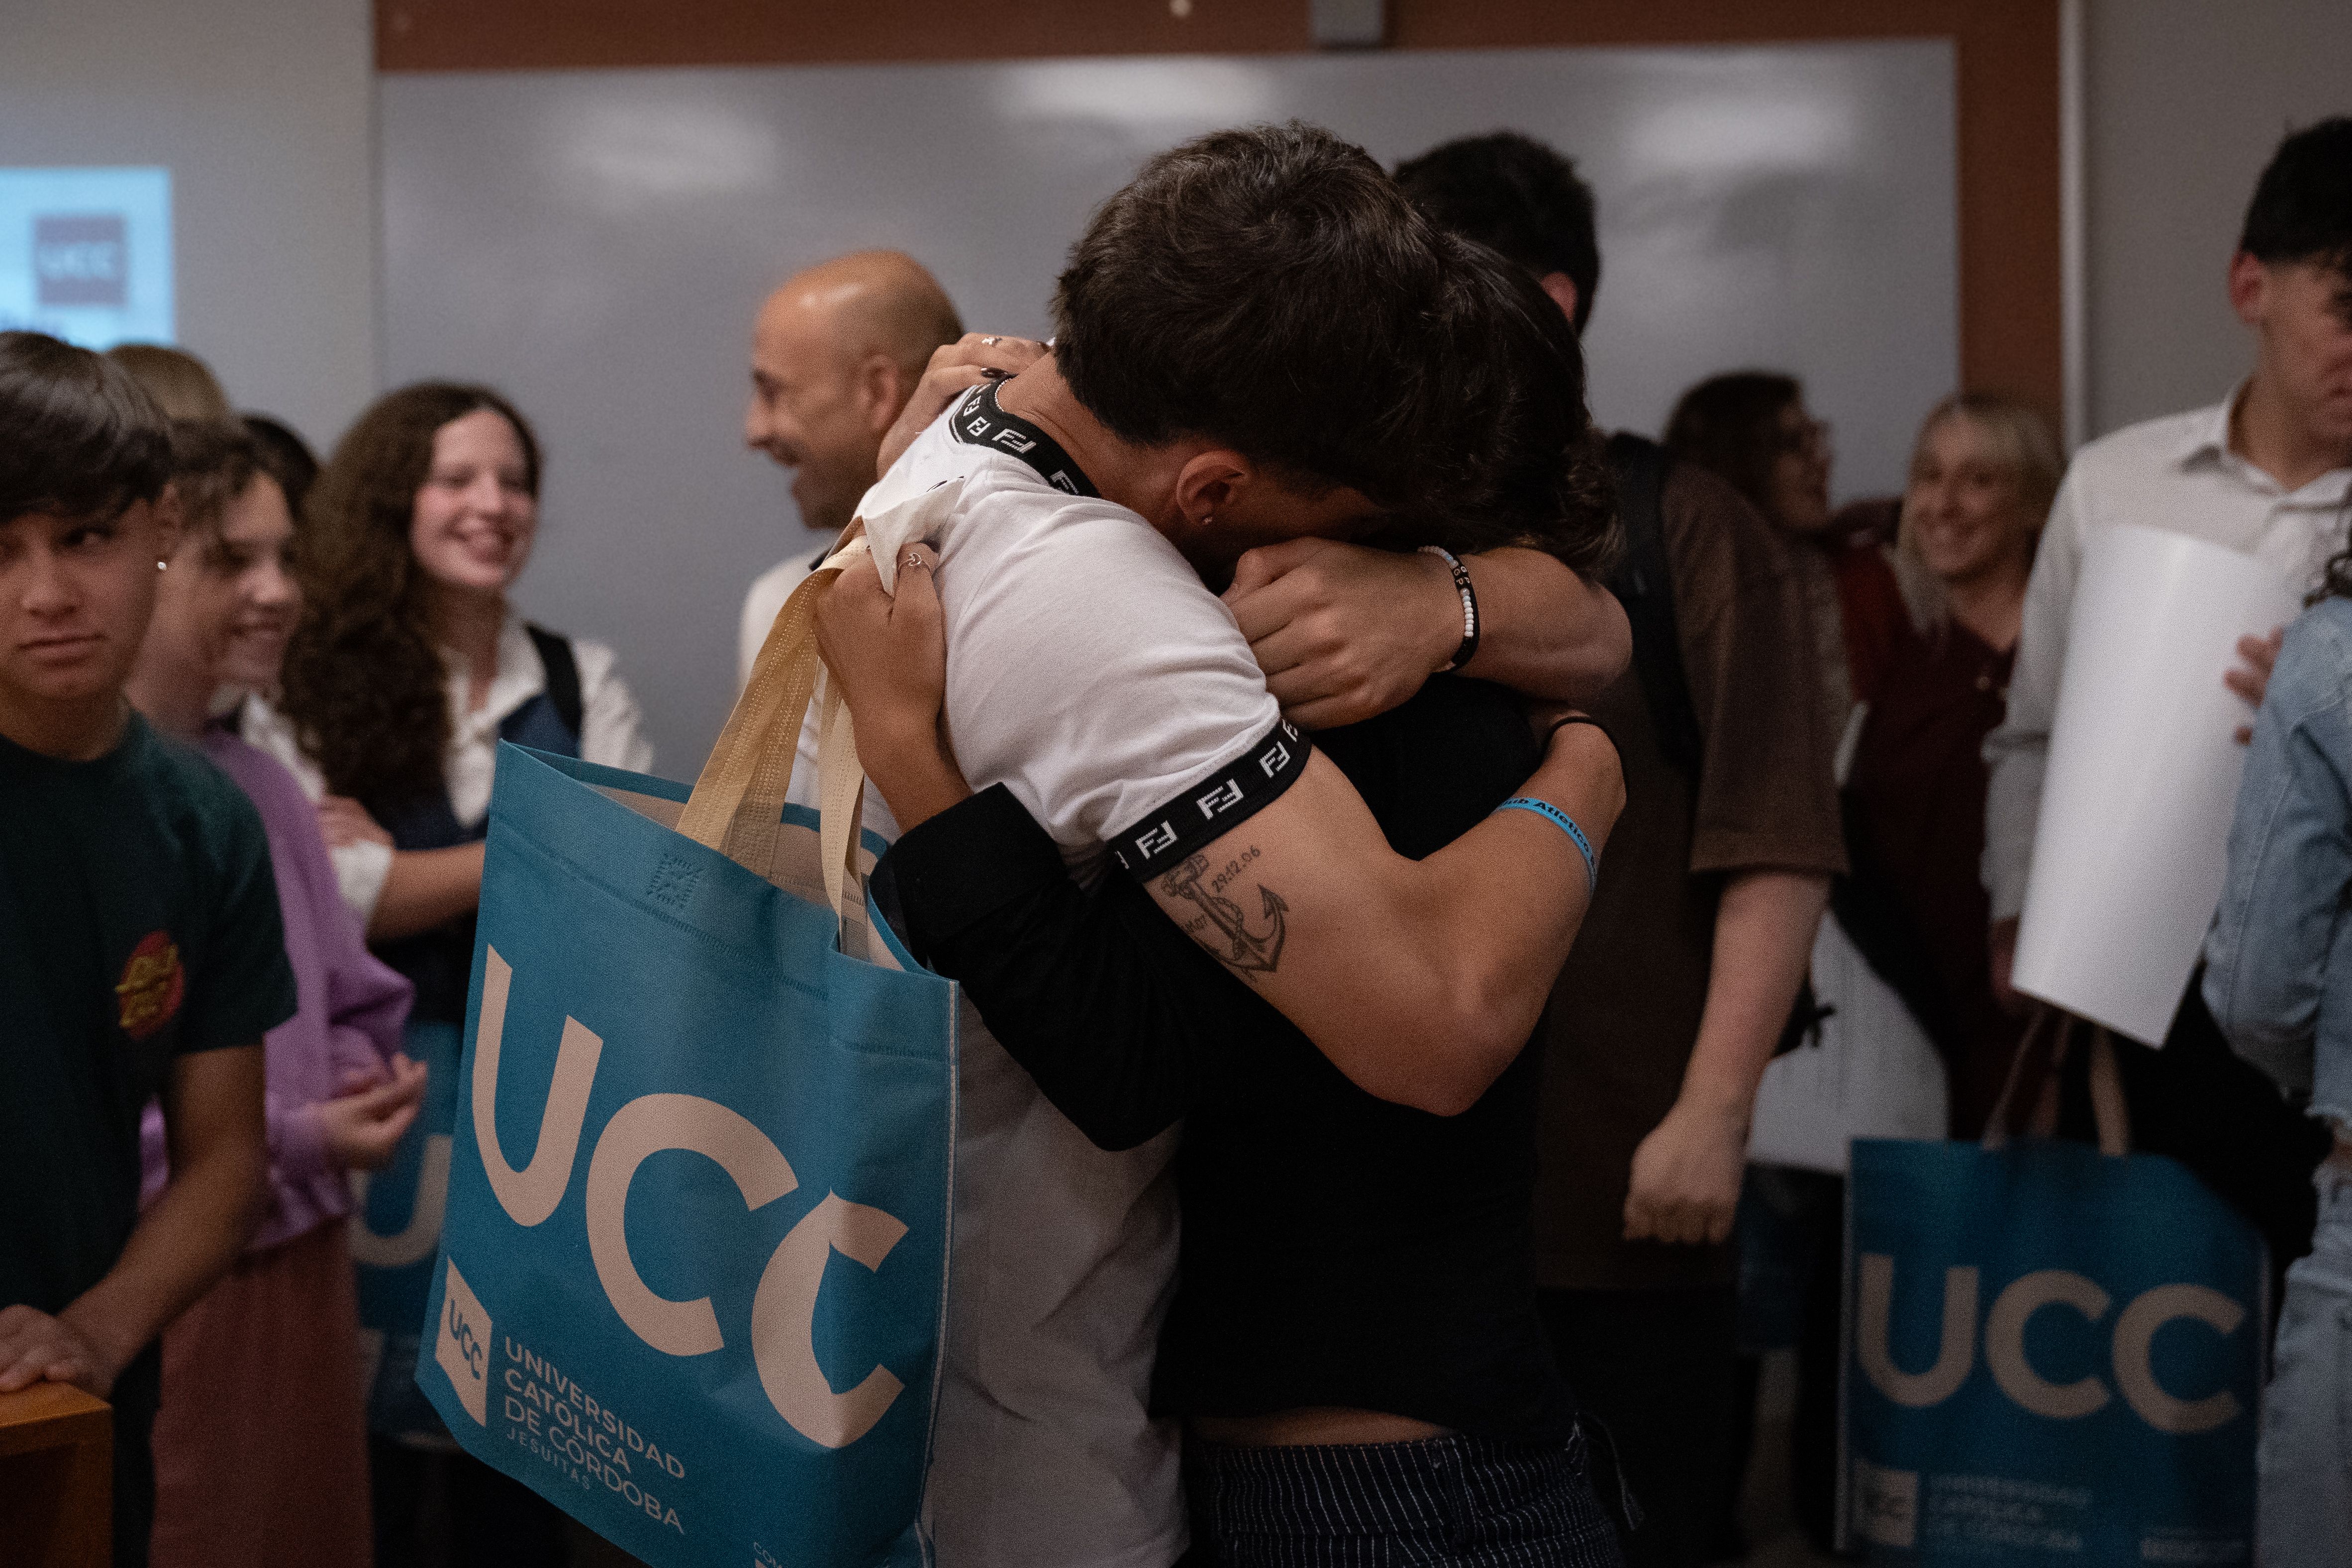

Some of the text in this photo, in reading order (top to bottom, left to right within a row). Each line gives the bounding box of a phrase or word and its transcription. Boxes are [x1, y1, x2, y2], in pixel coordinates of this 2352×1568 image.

[472, 943, 910, 1449] UCC
[449, 1298, 483, 1380] UCC
[505, 1336, 685, 1479] UNIVERSIDAD
[1856, 1252, 2248, 1435] UCC
[504, 1369, 631, 1473] CATÓLICA
[505, 1395, 684, 1535] DE CÓRDOBA
[506, 1427, 590, 1490] JESUITAS
